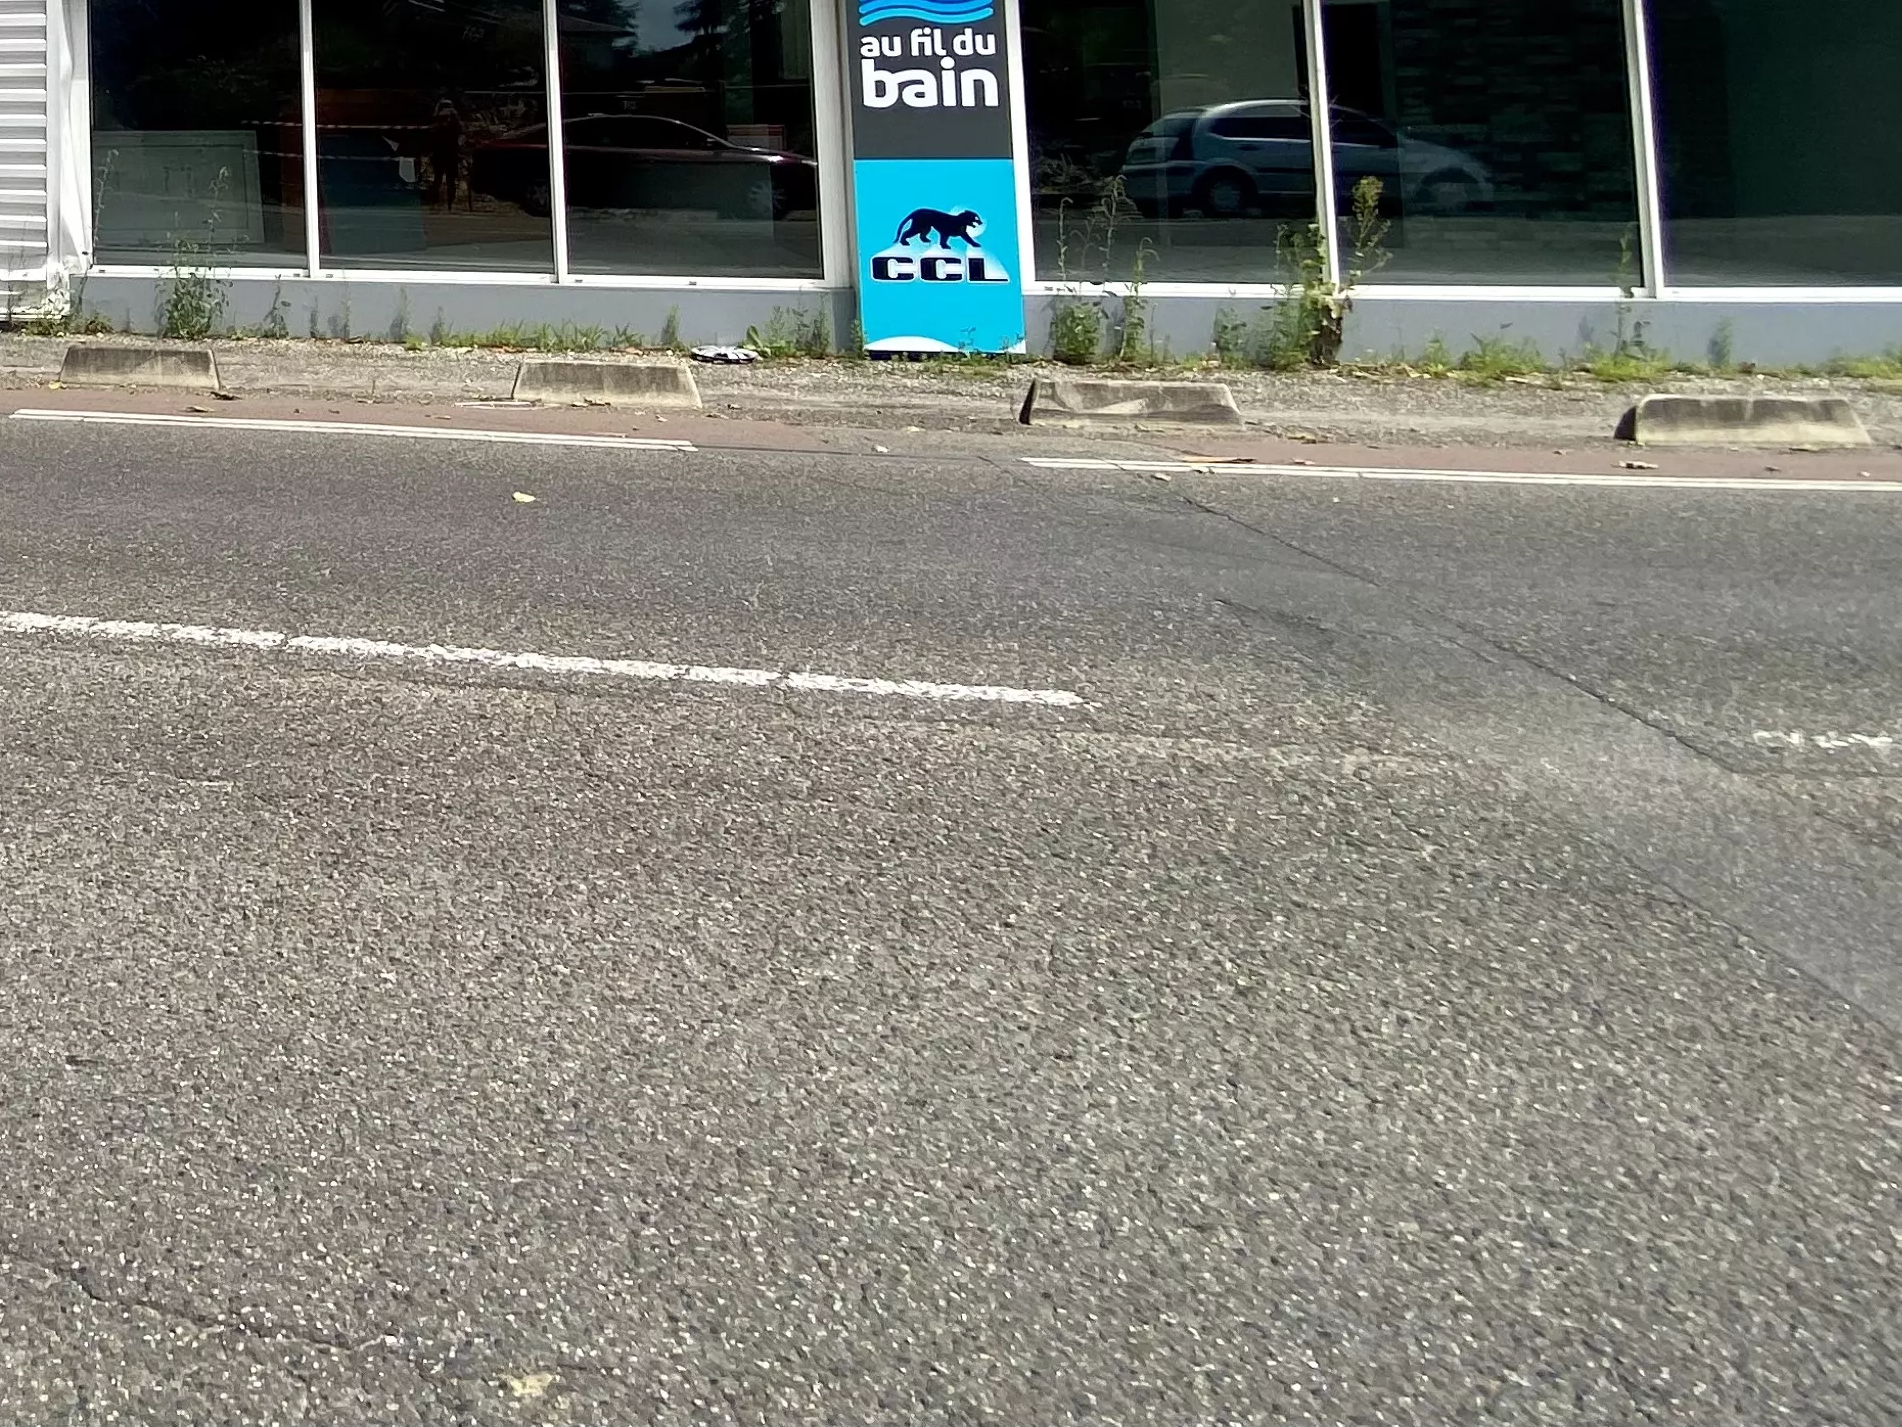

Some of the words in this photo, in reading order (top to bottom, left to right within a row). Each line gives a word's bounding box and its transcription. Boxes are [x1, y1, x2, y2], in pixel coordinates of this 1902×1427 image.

[860, 34, 901, 58] au
[910, 27, 947, 57] fil
[952, 27, 996, 56] du
[860, 56, 999, 108] bain
[870, 256, 1010, 282] CCL
